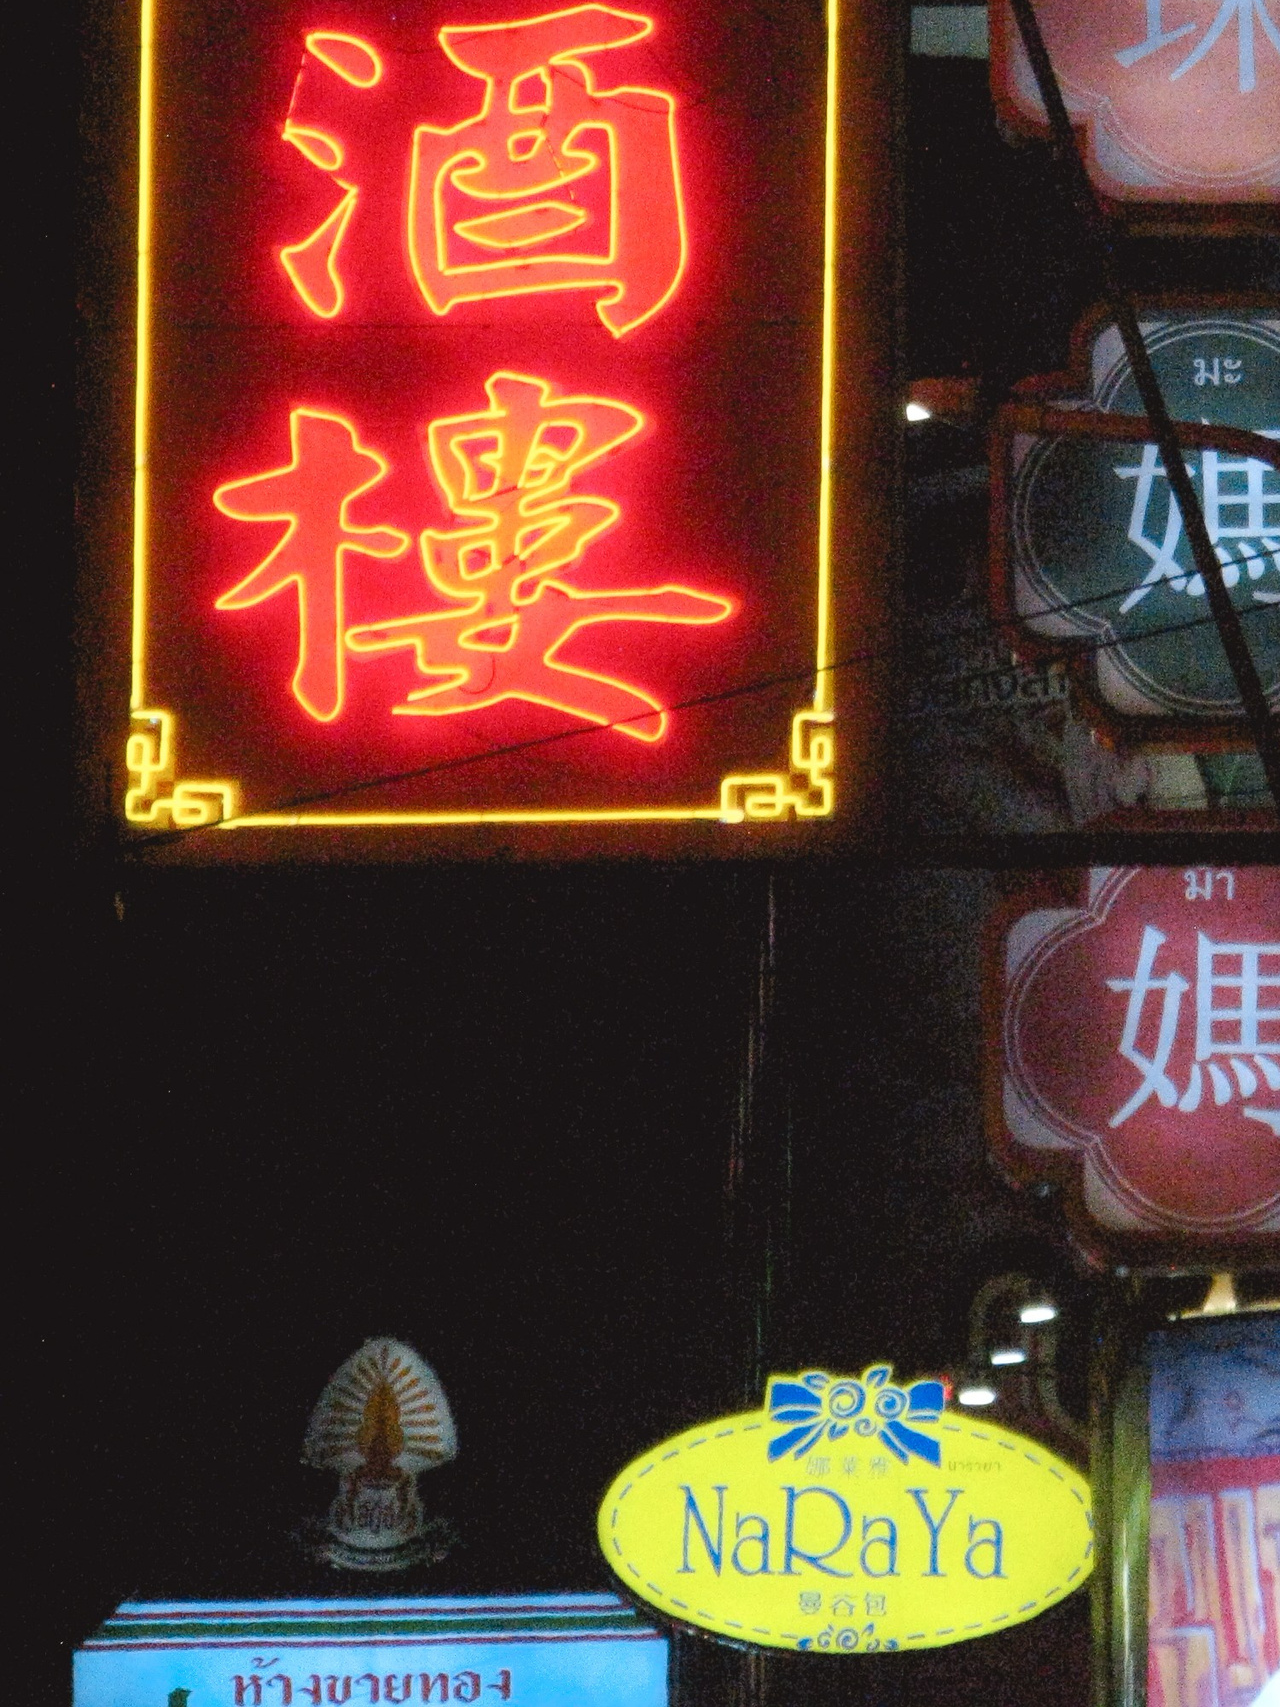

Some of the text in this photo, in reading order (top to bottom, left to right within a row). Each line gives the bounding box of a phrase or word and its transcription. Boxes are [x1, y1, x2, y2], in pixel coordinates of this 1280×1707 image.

[1192, 358, 1243, 387] มะ
[676, 1484, 1008, 1580] NaRaYa
[798, 1591, 888, 1617] 曼谷包
[230, 1656, 512, 1706] ห้างขายทอง
